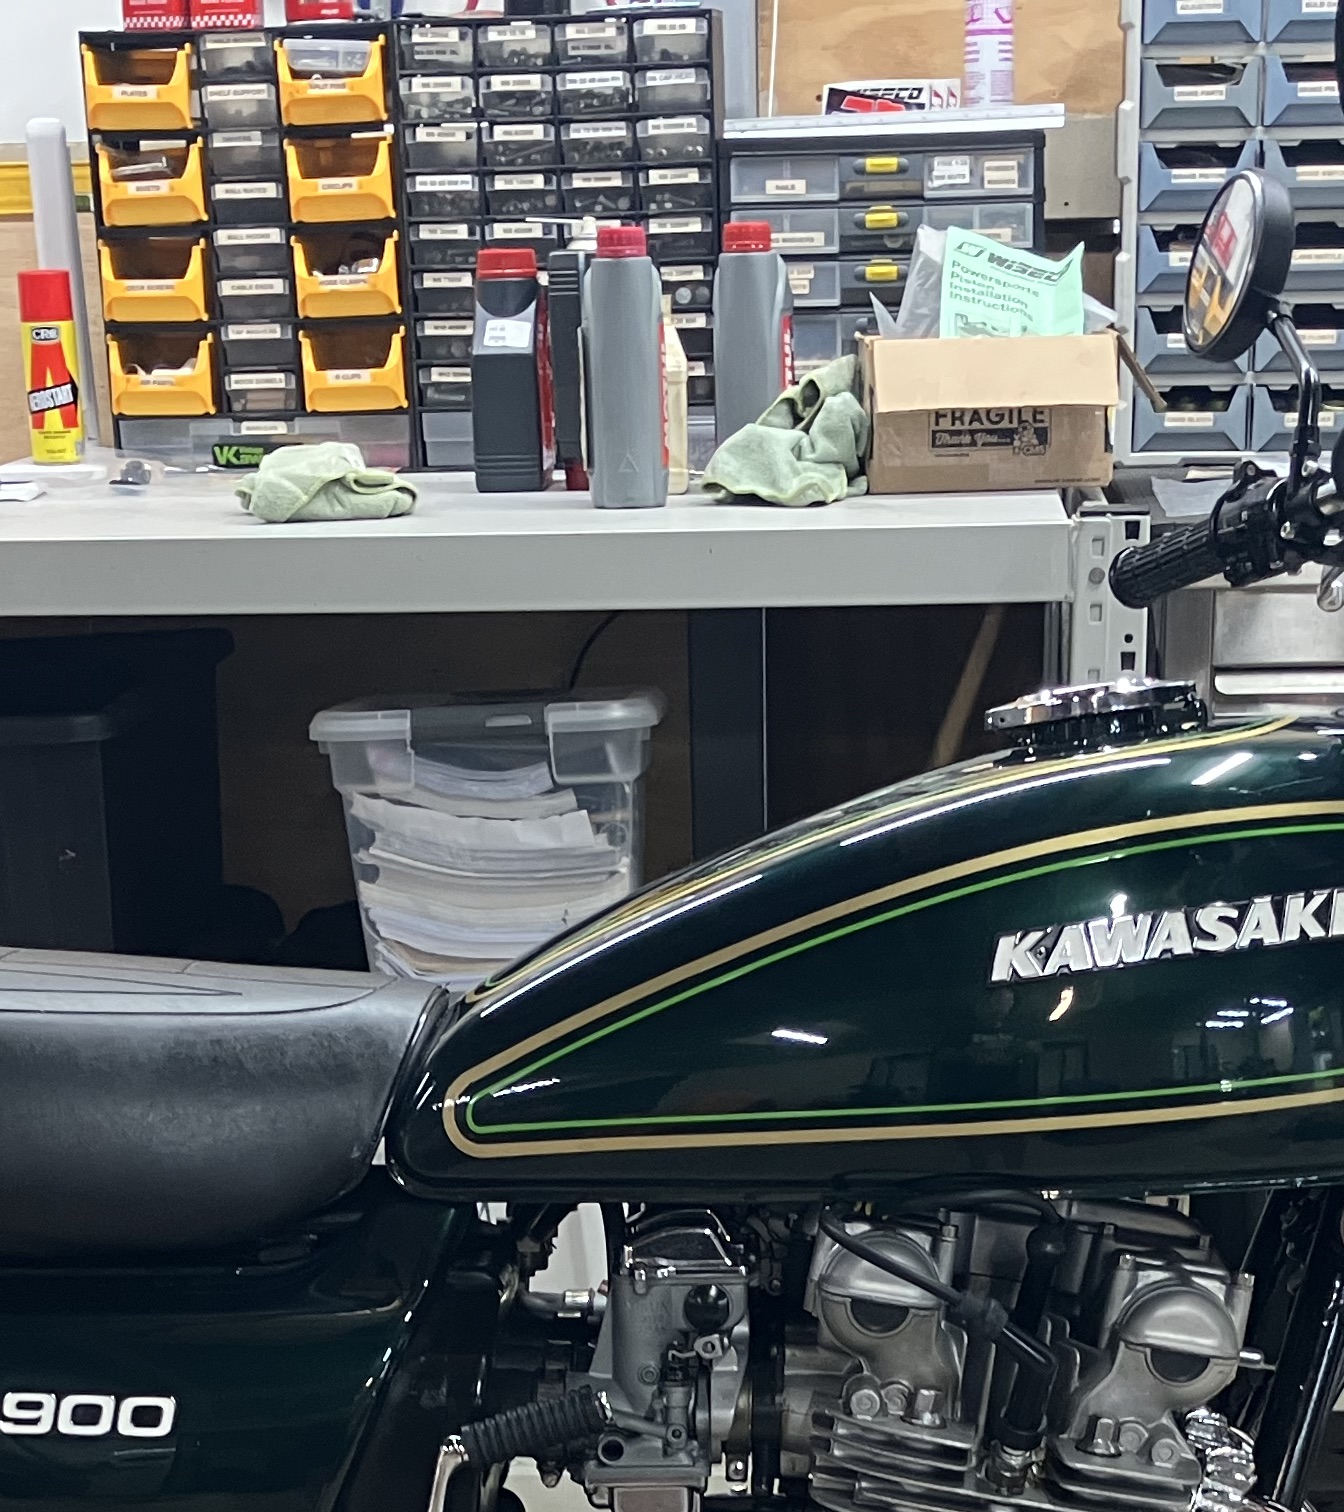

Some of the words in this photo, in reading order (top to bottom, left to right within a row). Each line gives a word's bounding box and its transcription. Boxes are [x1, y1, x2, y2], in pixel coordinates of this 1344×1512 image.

[950, 271, 995, 291] Piston
[952, 260, 1040, 297] Powersports
[949, 282, 1029, 309] Installation
[949, 291, 1034, 322] Instructions
[933, 408, 1046, 427] FRAGILE
